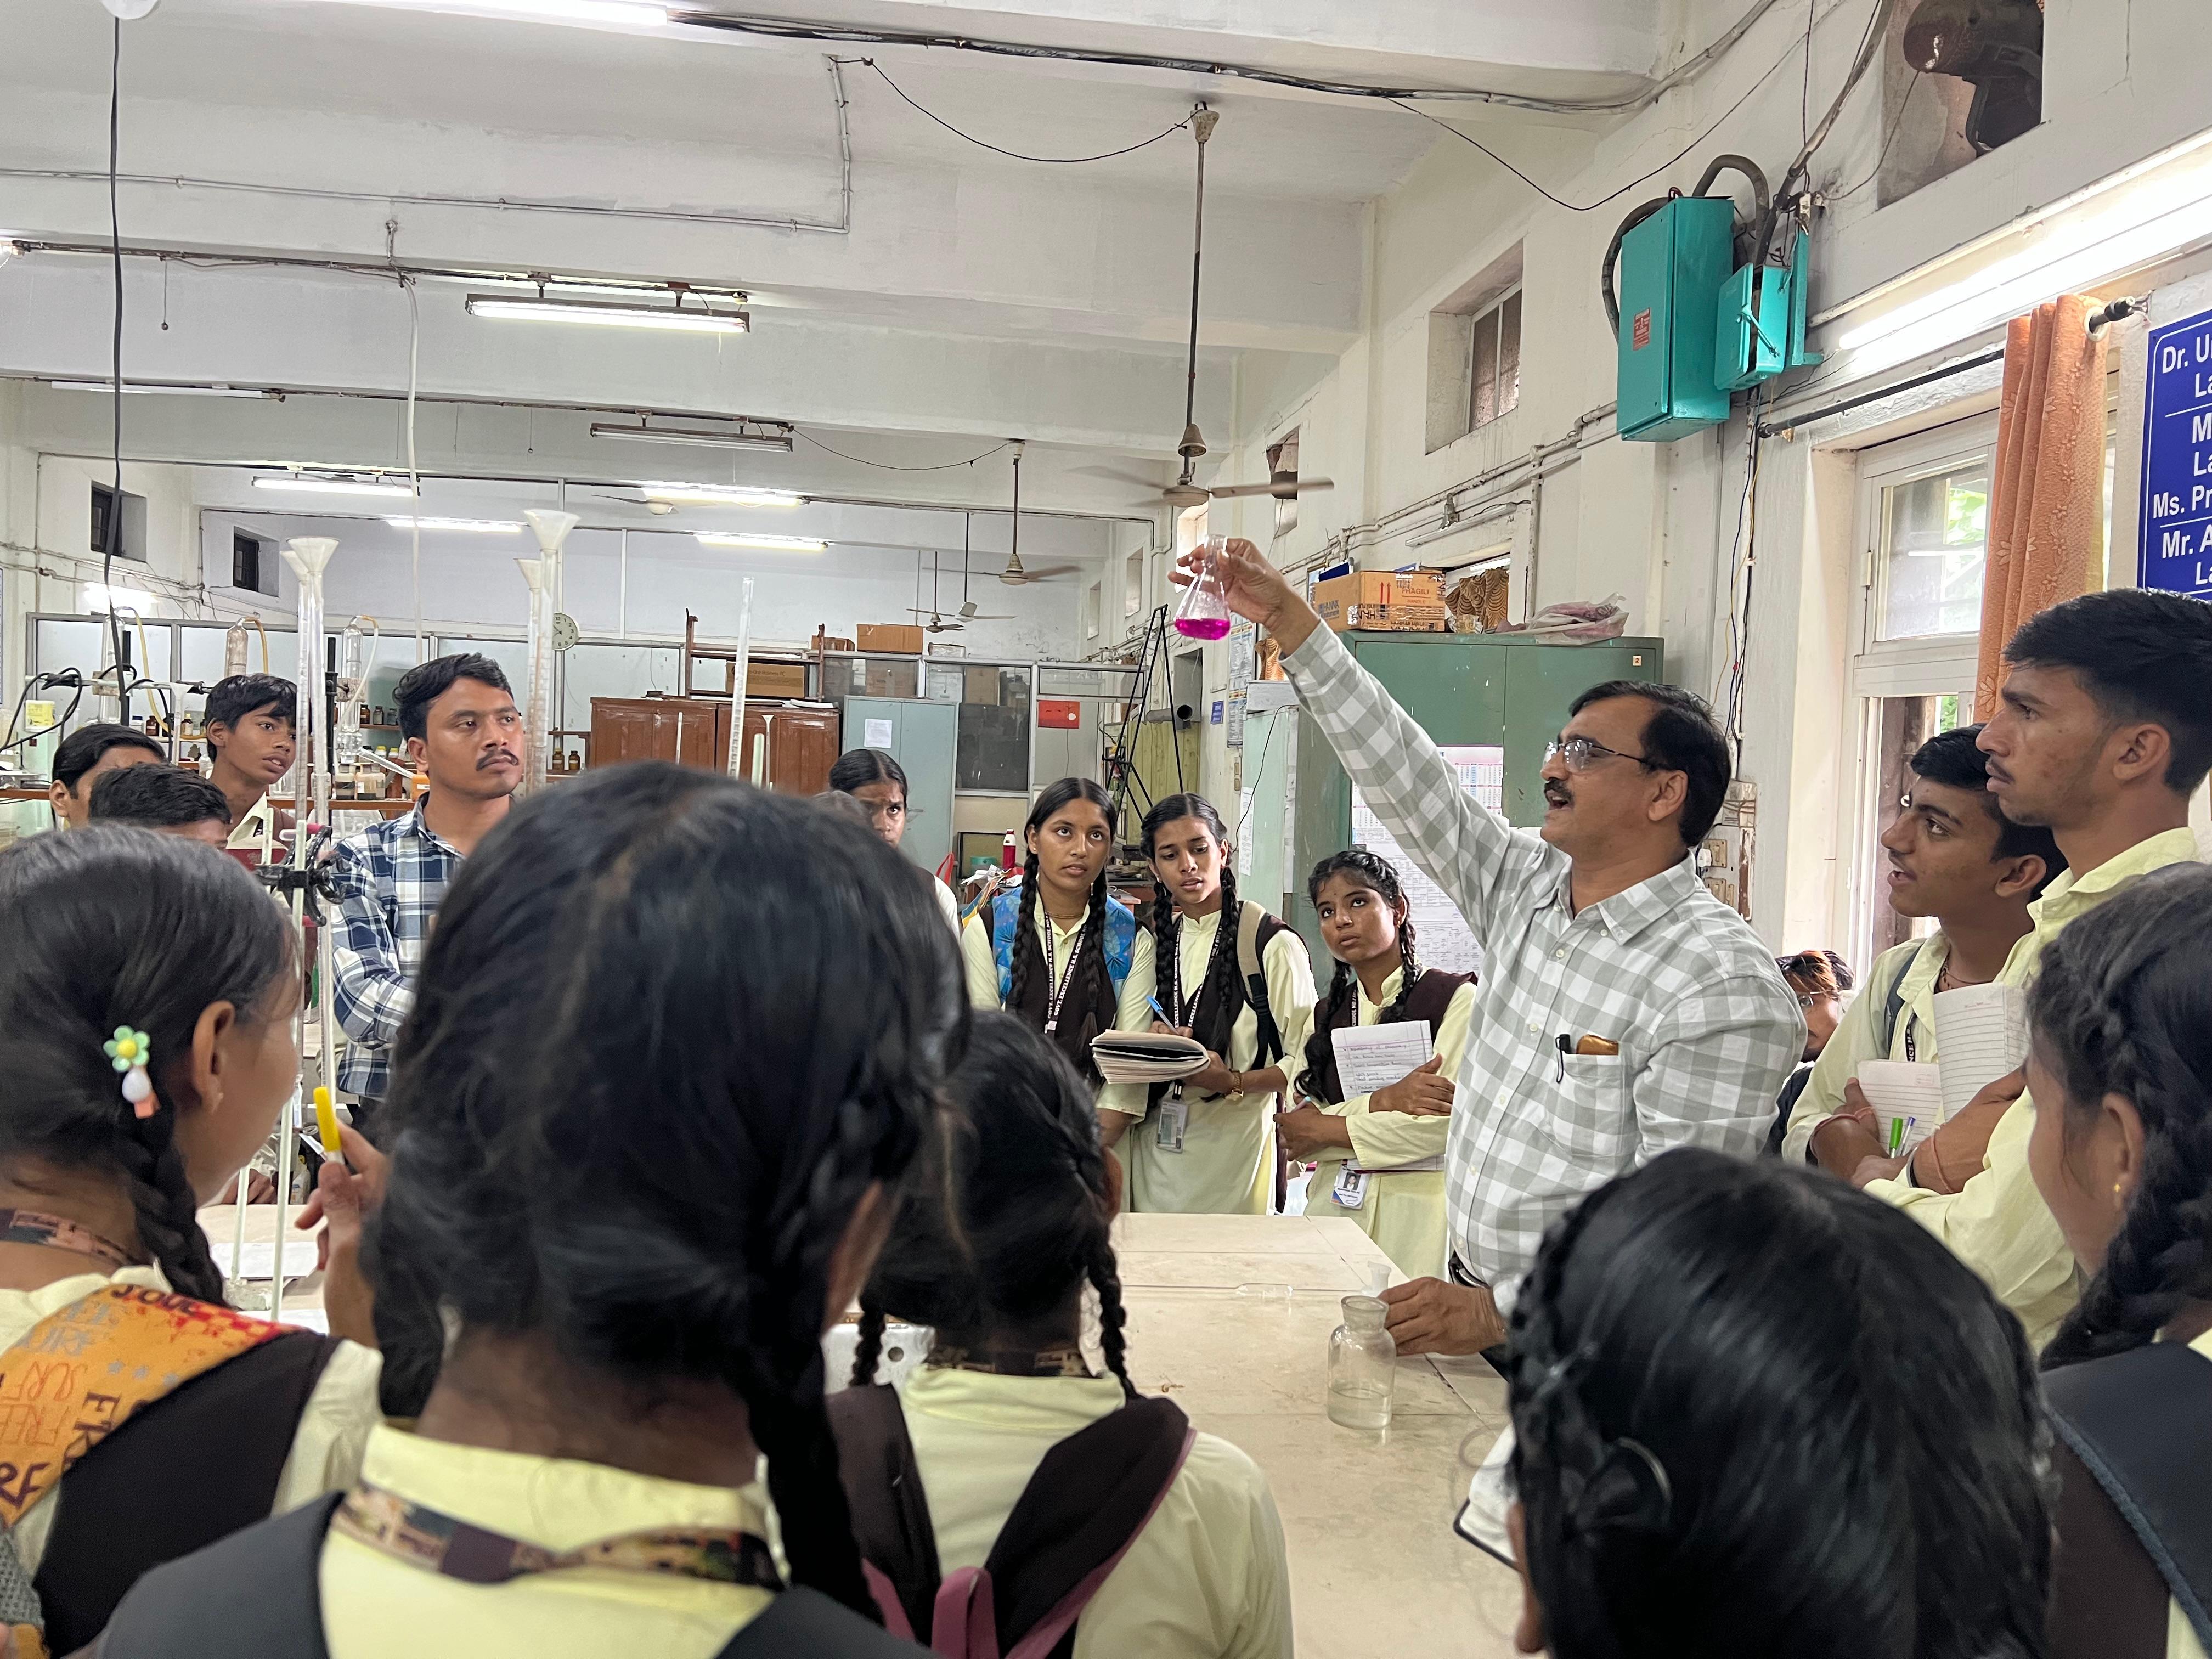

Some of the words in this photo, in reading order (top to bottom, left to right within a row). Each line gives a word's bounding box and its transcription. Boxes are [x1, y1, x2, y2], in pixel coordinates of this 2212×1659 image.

[2162, 346, 2188, 374] Dr.
[2196, 334, 2212, 363] U
[2153, 492, 2185, 518] Ms.
[2162, 530, 2193, 558] Mr.
[1074, 933, 1086, 954] SCHOOL
[1058, 964, 1074, 1000] EXCELLENCE
[1054, 1000, 1063, 1015] GOVT.
